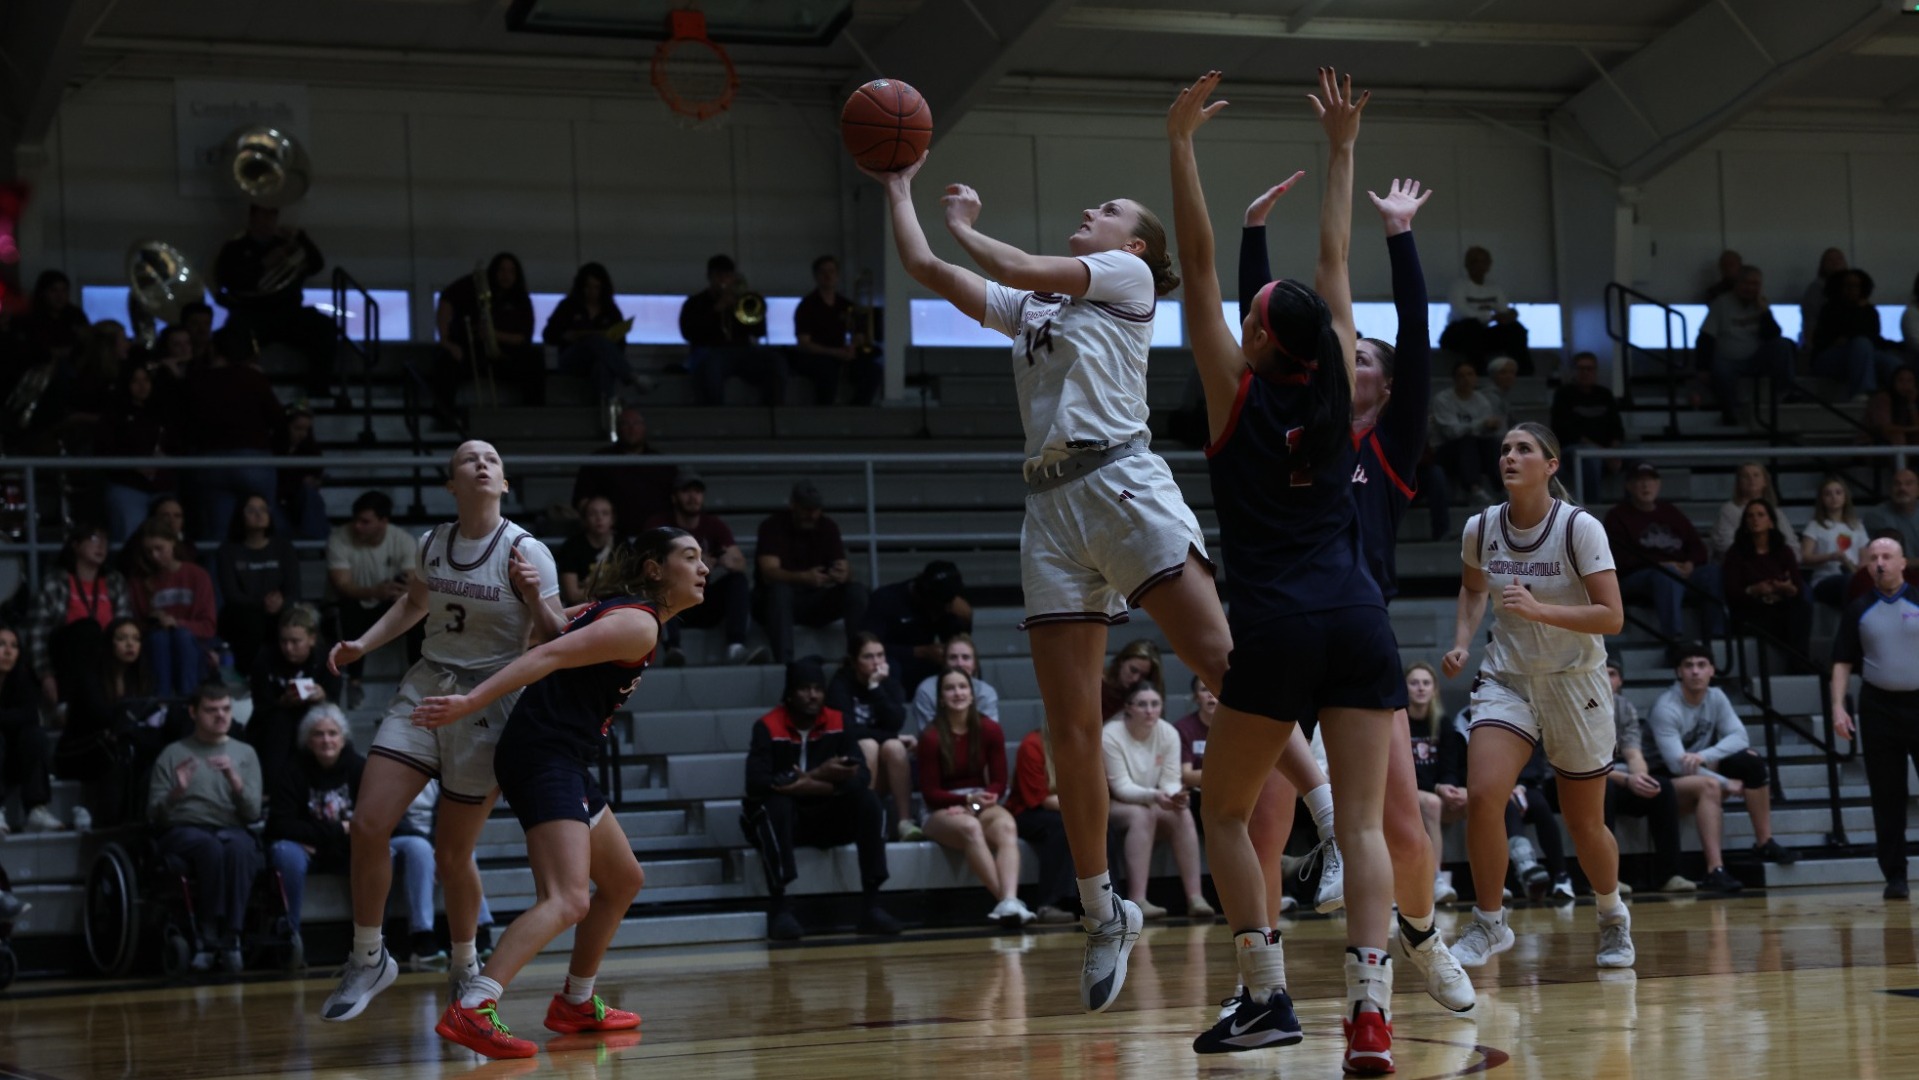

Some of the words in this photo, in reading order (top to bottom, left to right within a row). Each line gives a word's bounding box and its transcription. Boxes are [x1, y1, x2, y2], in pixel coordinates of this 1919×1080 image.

[1025, 319, 1053, 367] 14
[1488, 560, 1561, 577] CAMPBELLSVILLE
[445, 602, 466, 633] 3
